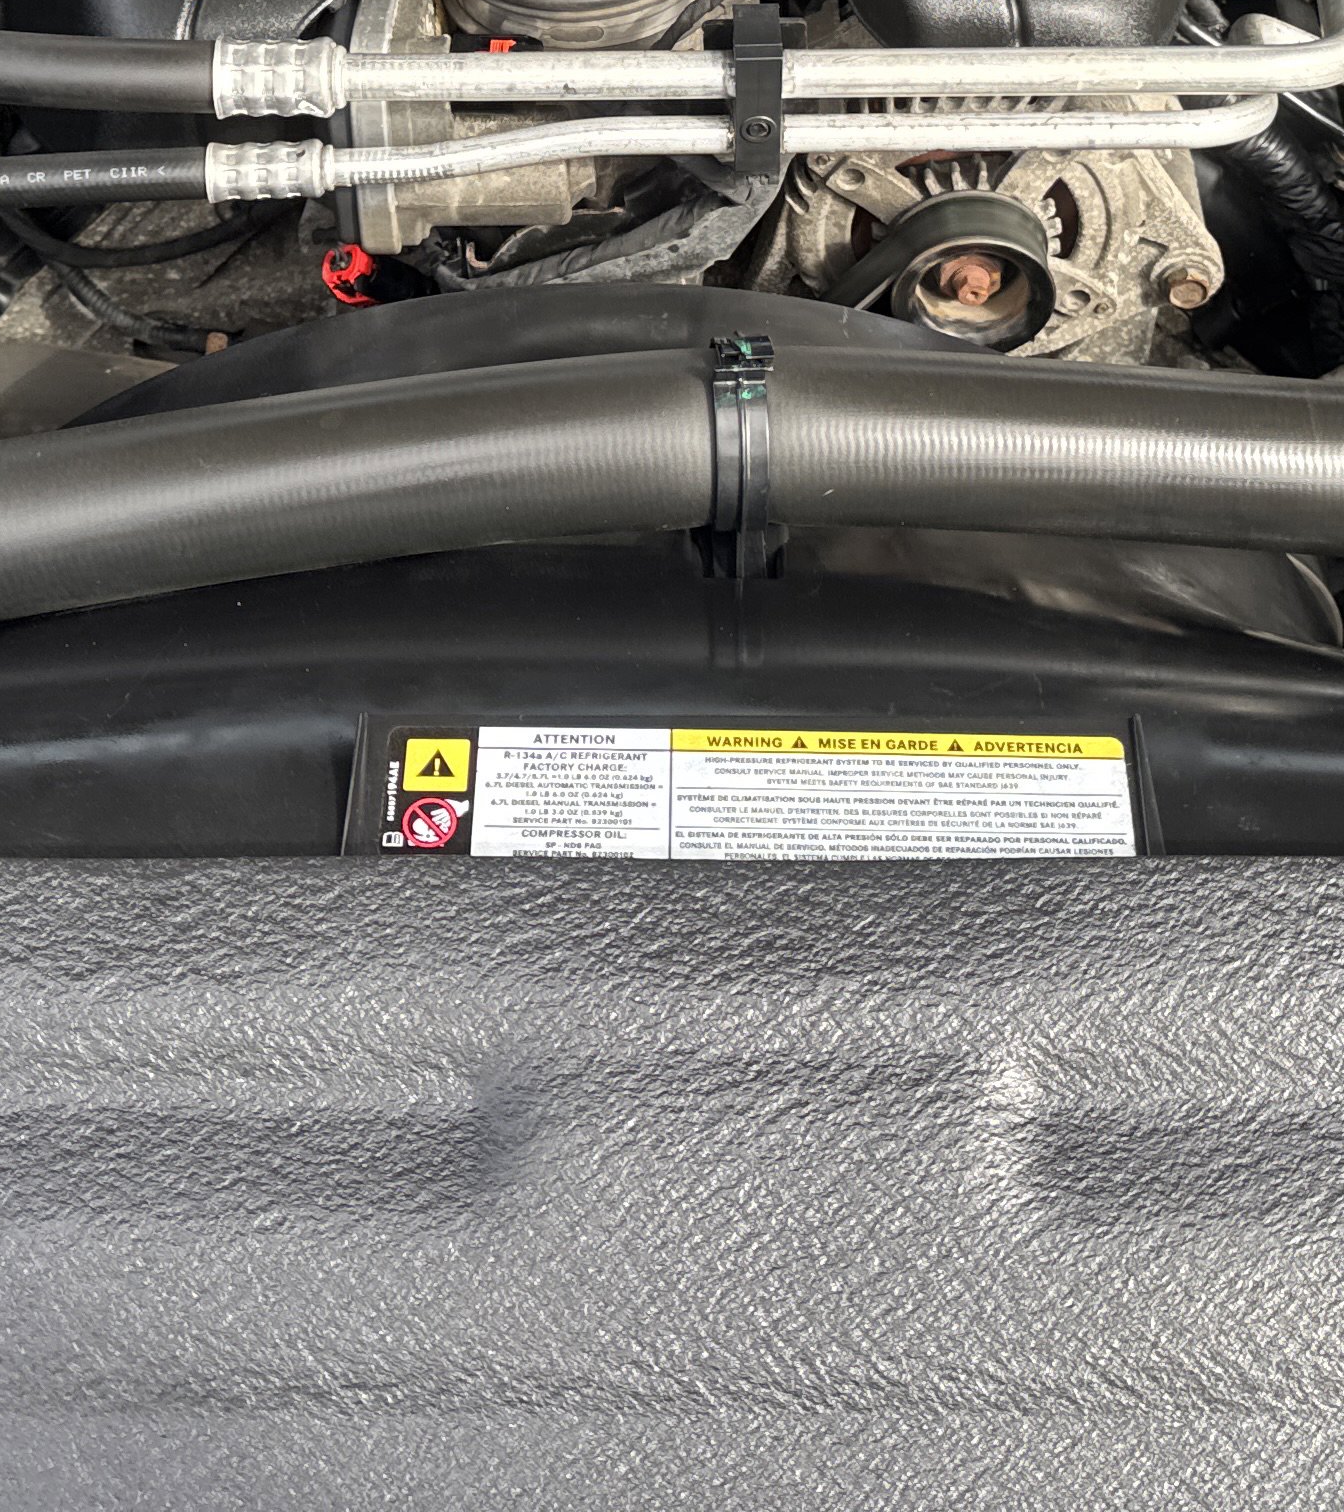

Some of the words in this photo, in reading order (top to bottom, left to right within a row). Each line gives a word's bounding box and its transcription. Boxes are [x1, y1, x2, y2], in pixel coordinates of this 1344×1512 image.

[27, 171, 46, 184] CR
[64, 168, 92, 181] PET
[533, 734, 616, 744] ATTENTION
[706, 737, 782, 747] WARNING
[818, 739, 856, 749] MISE
[860, 739, 881, 749] EN
[885, 740, 938, 750] GARDE
[974, 742, 1083, 753] ADVERTENCIA
[570, 752, 648, 760] REFRIGERANT
[523, 763, 574, 771] FACTORY
[521, 830, 601, 838] COMPRESSOR
